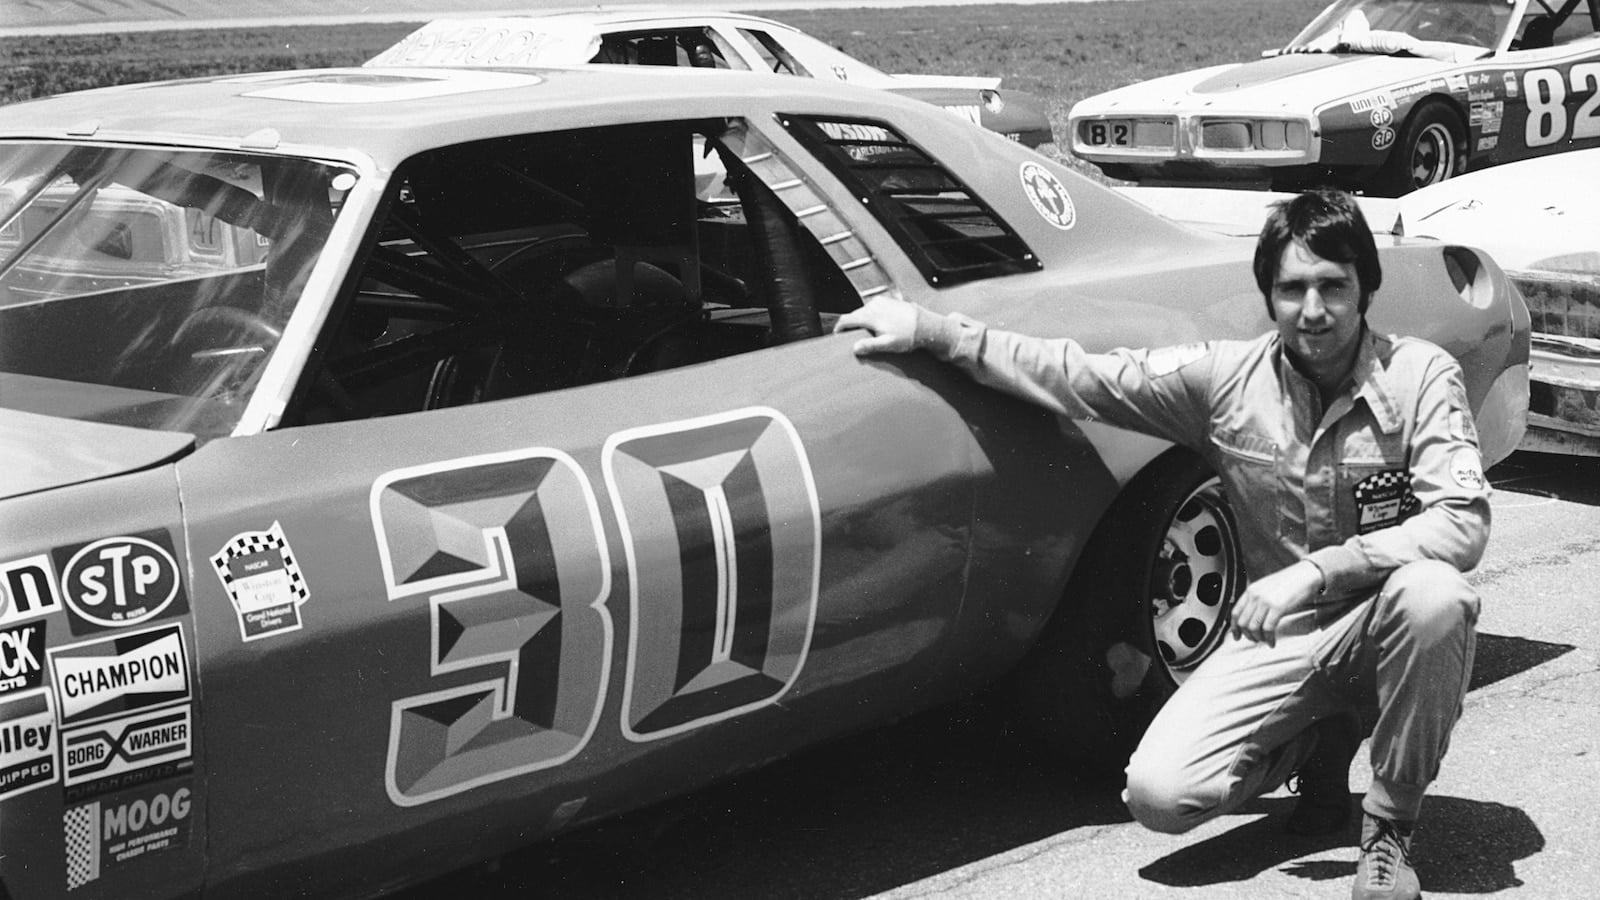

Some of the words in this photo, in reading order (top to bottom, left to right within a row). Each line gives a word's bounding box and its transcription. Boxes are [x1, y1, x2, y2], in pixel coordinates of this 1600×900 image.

[1523, 62, 1600, 147] 82
[1091, 124, 1128, 146] 82
[1374, 130, 1393, 146] STP
[0, 565, 55, 613] n
[79, 544, 161, 606] STP
[369, 406, 821, 807] 30
[64, 651, 180, 698] CHAMPION
[67, 742, 105, 766] BORG
[129, 724, 187, 751] WARNER
[104, 787, 191, 840] MOOG
